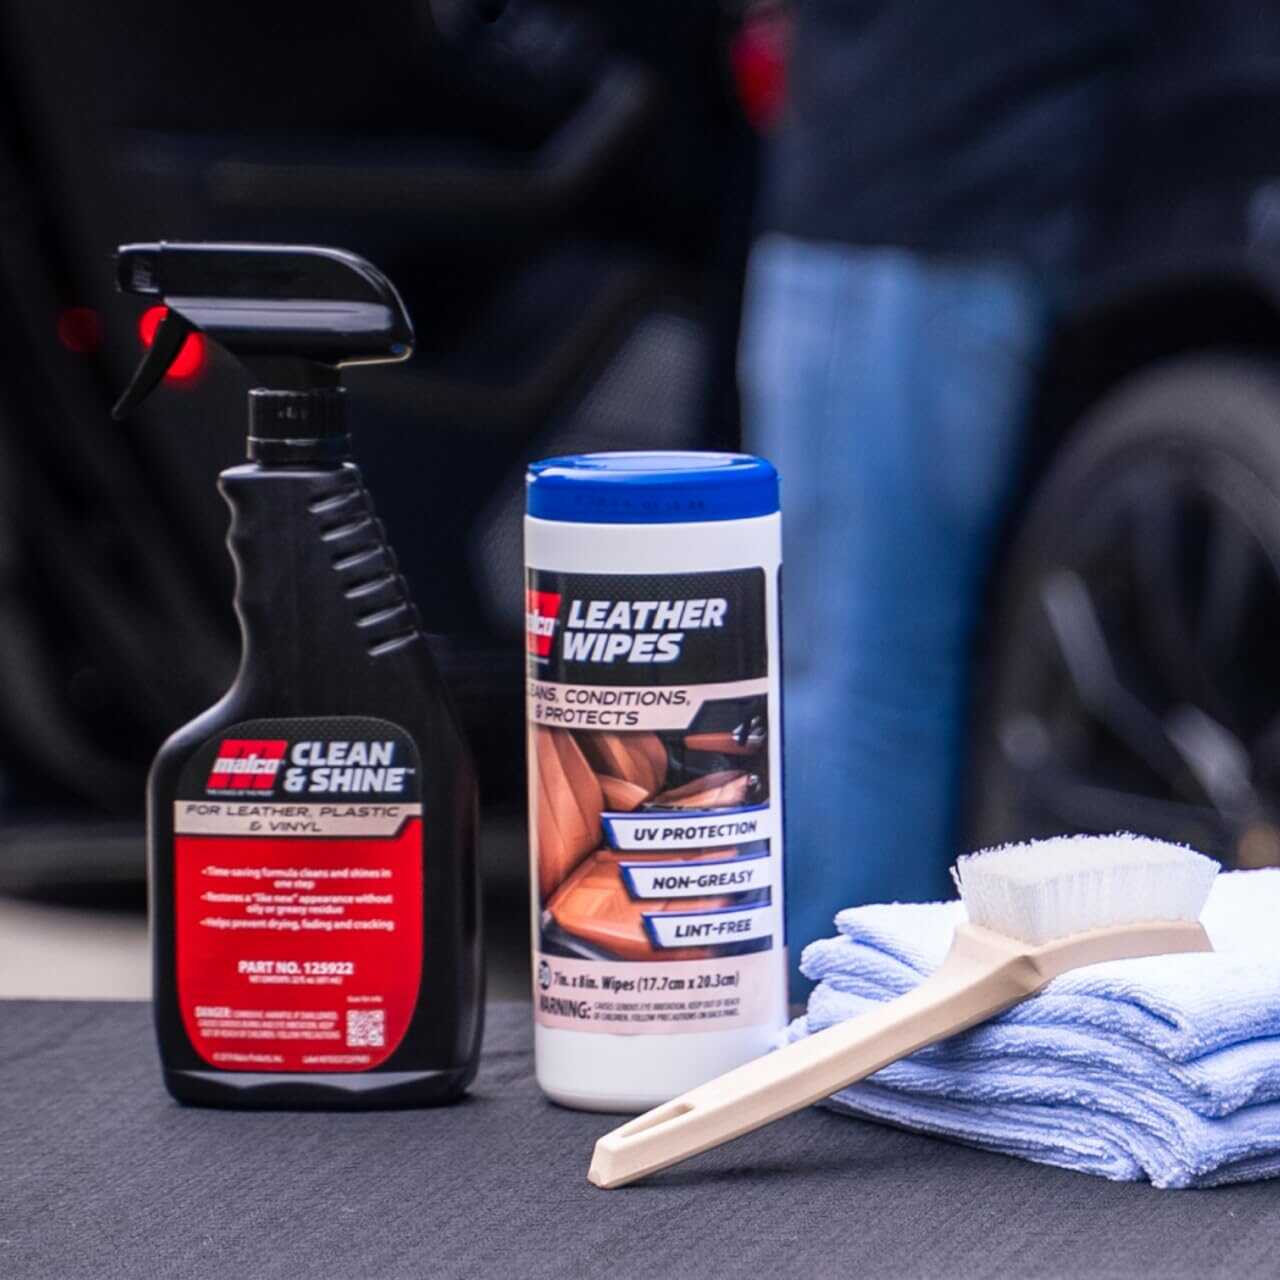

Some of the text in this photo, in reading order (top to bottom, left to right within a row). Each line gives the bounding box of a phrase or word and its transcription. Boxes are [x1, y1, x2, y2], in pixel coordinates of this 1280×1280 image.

[567, 598, 727, 630] LEATHER
[563, 632, 684, 663] WIPES
[565, 690, 691, 707] CONDITIONS,
[545, 706, 639, 726] PROTECTS
[290, 741, 394, 766] CLEAN
[212, 754, 280, 775] malco
[283, 768, 303, 792] &
[186, 804, 219, 816] FOR
[320, 806, 399, 818] PLASTIC
[249, 821, 322, 833] & VINYL
[634, 820, 757, 841] UV PROTECTION
[330, 869, 348, 878] and
[652, 870, 753, 890] NON-GREASY
[334, 920, 351, 930] and
[675, 919, 752, 938] LINT-FREE
[238, 961, 354, 975] PART NO. 125922
[602, 976, 635, 993] Wipes
[689, 978, 695, 989] x
